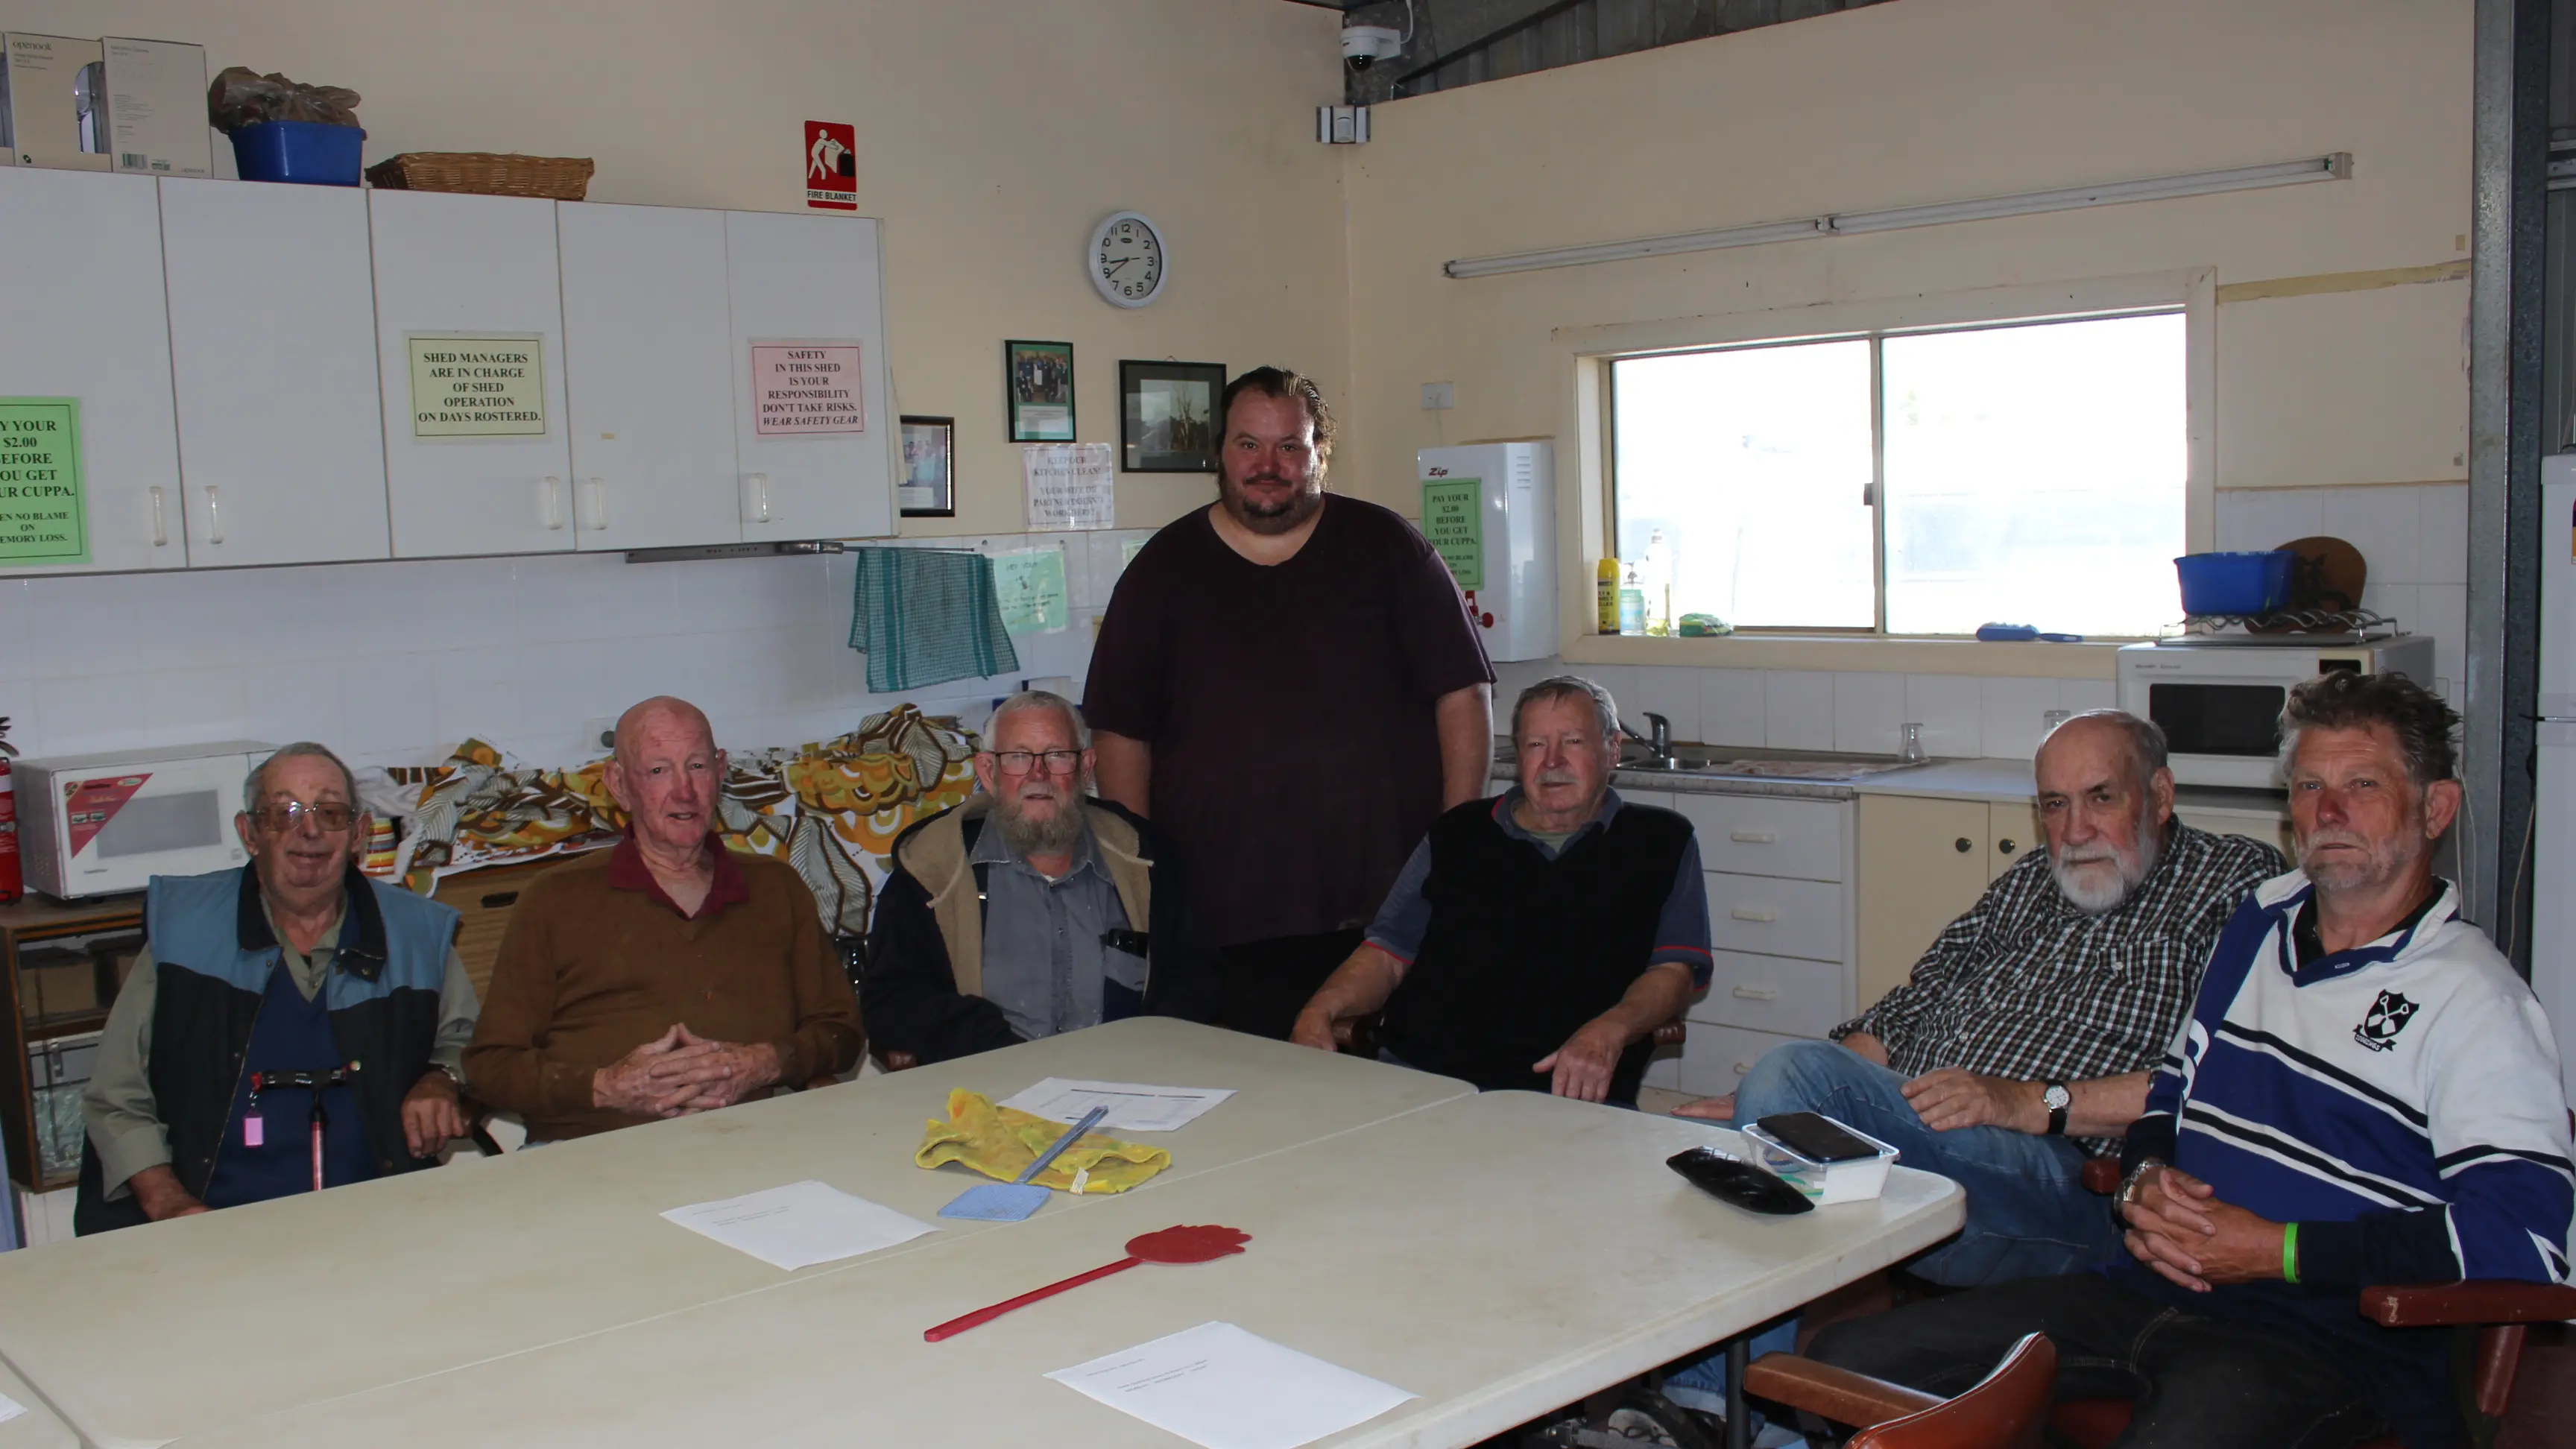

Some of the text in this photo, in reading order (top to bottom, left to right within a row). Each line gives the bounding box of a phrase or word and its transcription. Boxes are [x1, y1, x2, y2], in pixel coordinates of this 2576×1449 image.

[807, 190, 856, 201] FIRE BLANKET
[1111, 226, 1117, 236] 11
[1121, 224, 1131, 233] 12
[1102, 238, 1111, 247] 0
[1143, 240, 1152, 250] 2
[1146, 256, 1155, 267] 3
[1144, 271, 1152, 281] 4
[1111, 280, 1120, 291] 7
[1123, 285, 1133, 297] 6
[1136, 282, 1144, 293] 5
[423, 353, 528, 364] SHED MANAGERS
[787, 350, 827, 360] SAFETY
[429, 367, 525, 378] ARE IN CHARGE
[775, 363, 841, 372] IN THIS SHED
[789, 376, 830, 386] IS YOUR
[452, 382, 505, 393] OF SHED
[768, 390, 850, 400] RESPONSIBILITY
[443, 397, 515, 407] OPERATION
[763, 402, 857, 414] DON'T TAKE RISKS.
[418, 411, 542, 423] ON DAYS ROSTERED.
[763, 415, 859, 426] WEAR SAFETY GEAR
[12, 420, 57, 432] YOUR
[3, 437, 37, 448] $2.00
[0, 452, 53, 464] EFORE
[0, 469, 58, 482] OU GET
[1428, 467, 1449, 478] Zip
[22, 485, 75, 497] CUPPA.
[1432, 493, 1469, 503] PAY YOUR
[32, 511, 69, 520] BLAME
[1436, 515, 1465, 524] BEFORE
[20, 523, 35, 531] ON
[1434, 527, 1451, 535] YOU
[0, 535, 36, 543] EMORY
